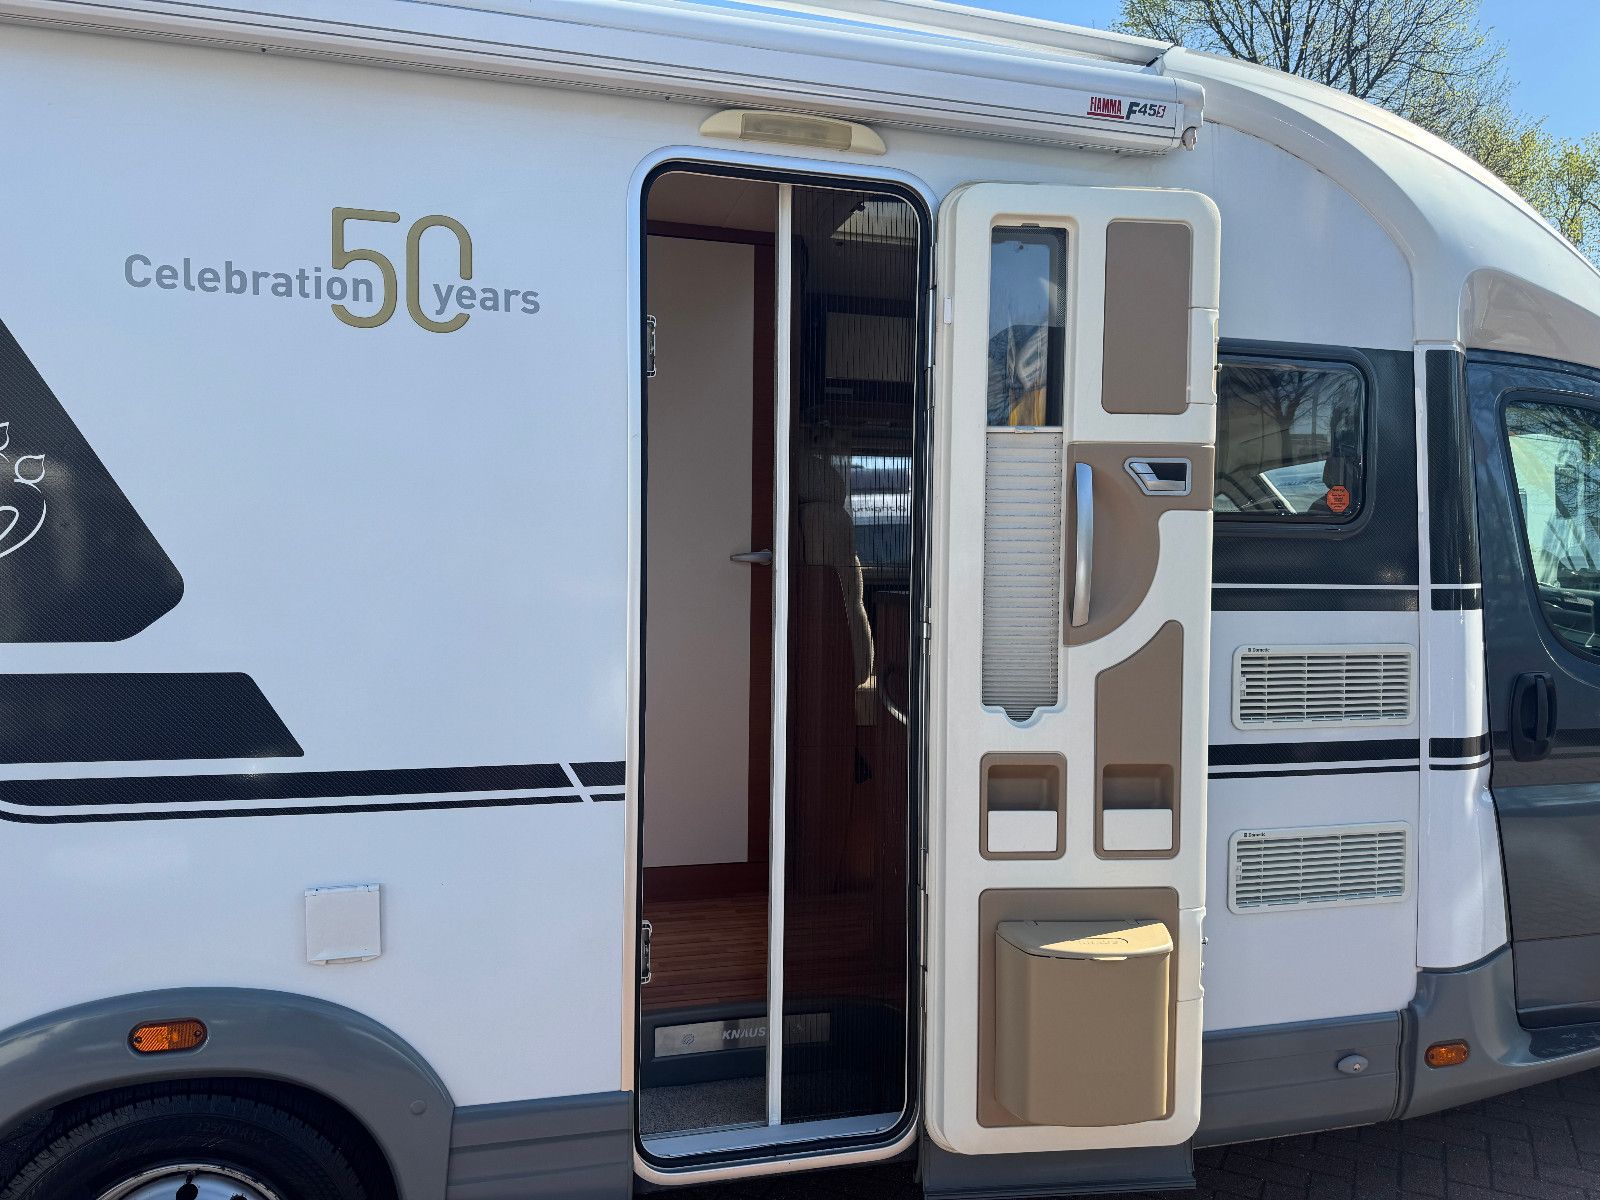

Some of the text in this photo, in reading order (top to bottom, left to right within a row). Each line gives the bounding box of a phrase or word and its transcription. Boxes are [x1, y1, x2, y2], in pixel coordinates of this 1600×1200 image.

[1089, 96, 1122, 115] FIAMMA
[124, 206, 541, 333] Celebration 50 years
[722, 1026, 767, 1041] KNAUS
